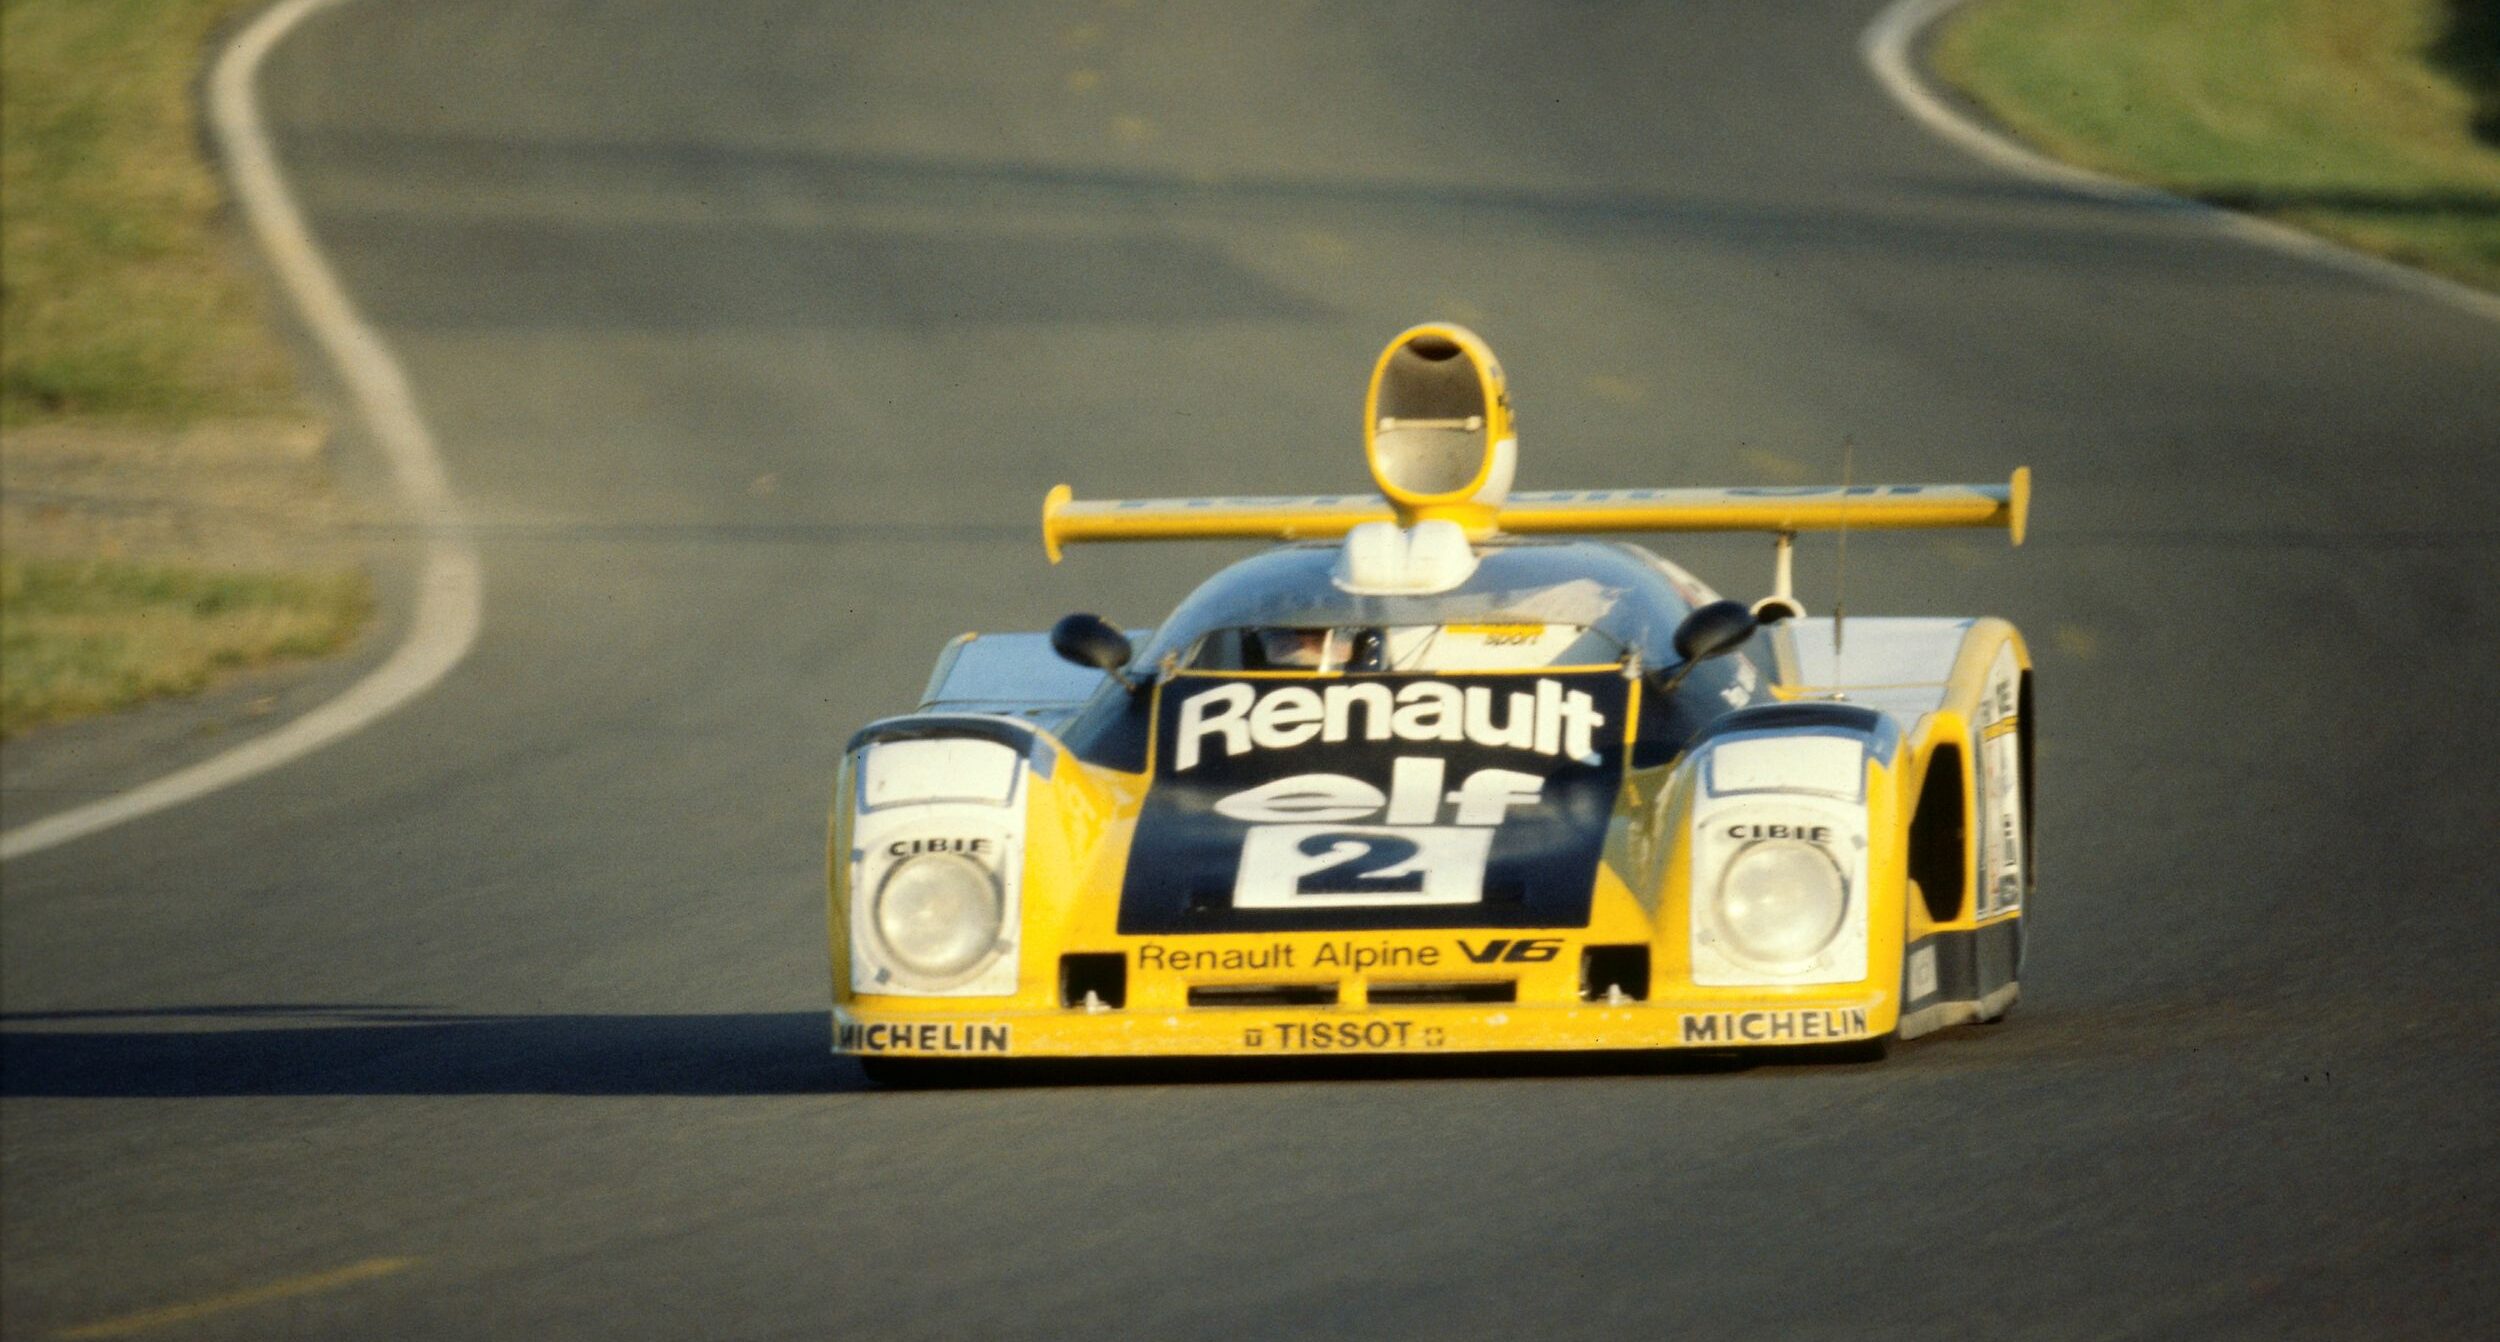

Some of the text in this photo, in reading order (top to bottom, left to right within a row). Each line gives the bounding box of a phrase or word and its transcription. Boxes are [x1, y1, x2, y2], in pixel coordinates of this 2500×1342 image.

[1175, 678, 1604, 771] Renault
[1214, 756, 1545, 825] elf
[1296, 832, 1424, 895] 2
[1138, 938, 1564, 972] Renault Alpine V6
[1274, 1021, 1413, 1048] TISSOT
[1684, 1008, 1867, 1042] MICHELIN
